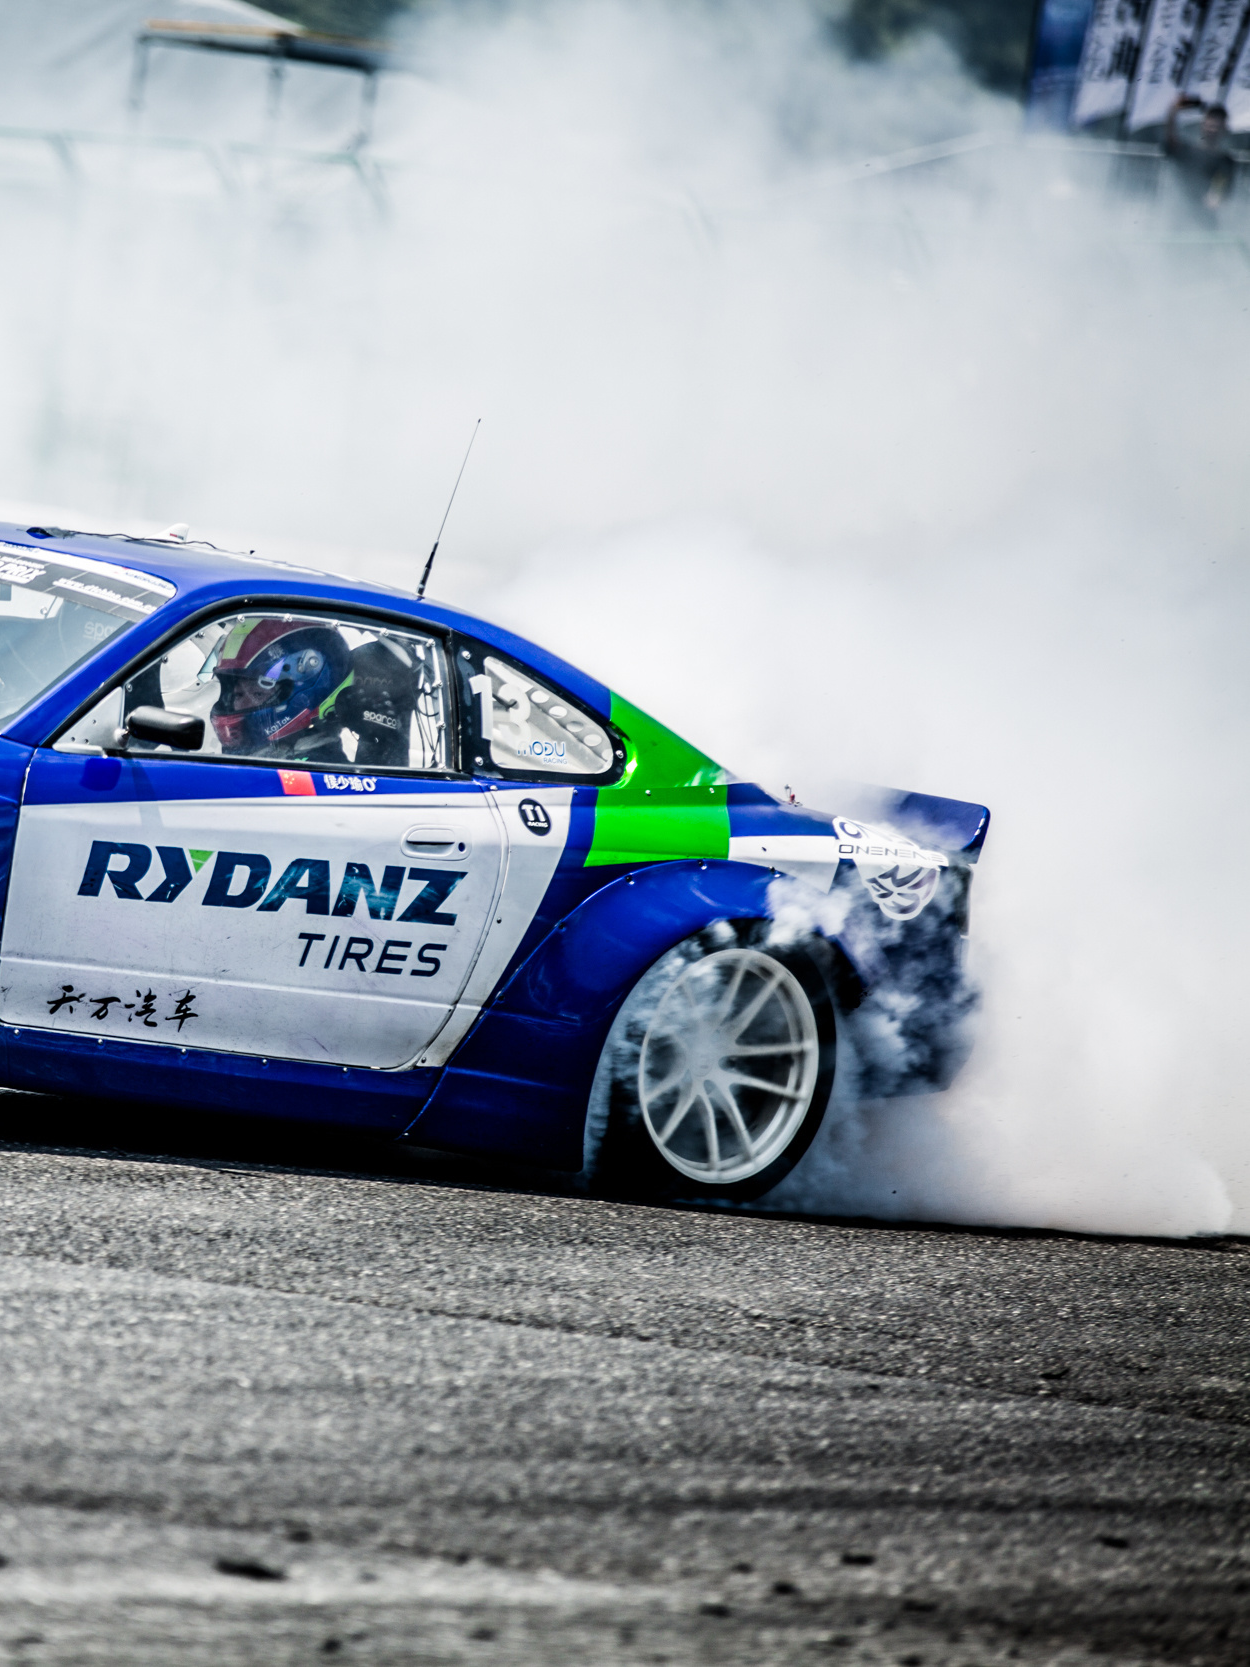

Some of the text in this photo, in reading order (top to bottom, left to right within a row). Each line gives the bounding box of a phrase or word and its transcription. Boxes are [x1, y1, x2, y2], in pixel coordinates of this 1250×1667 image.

[0, 563, 47, 580] PRIX
[468, 673, 532, 745] 13
[264, 716, 292, 736] KaiTak
[363, 710, 397, 728] sparco
[543, 757, 568, 765] RACING
[521, 804, 546, 822] T1
[77, 840, 469, 926] RYDANZ
[298, 932, 449, 978] TIRES
